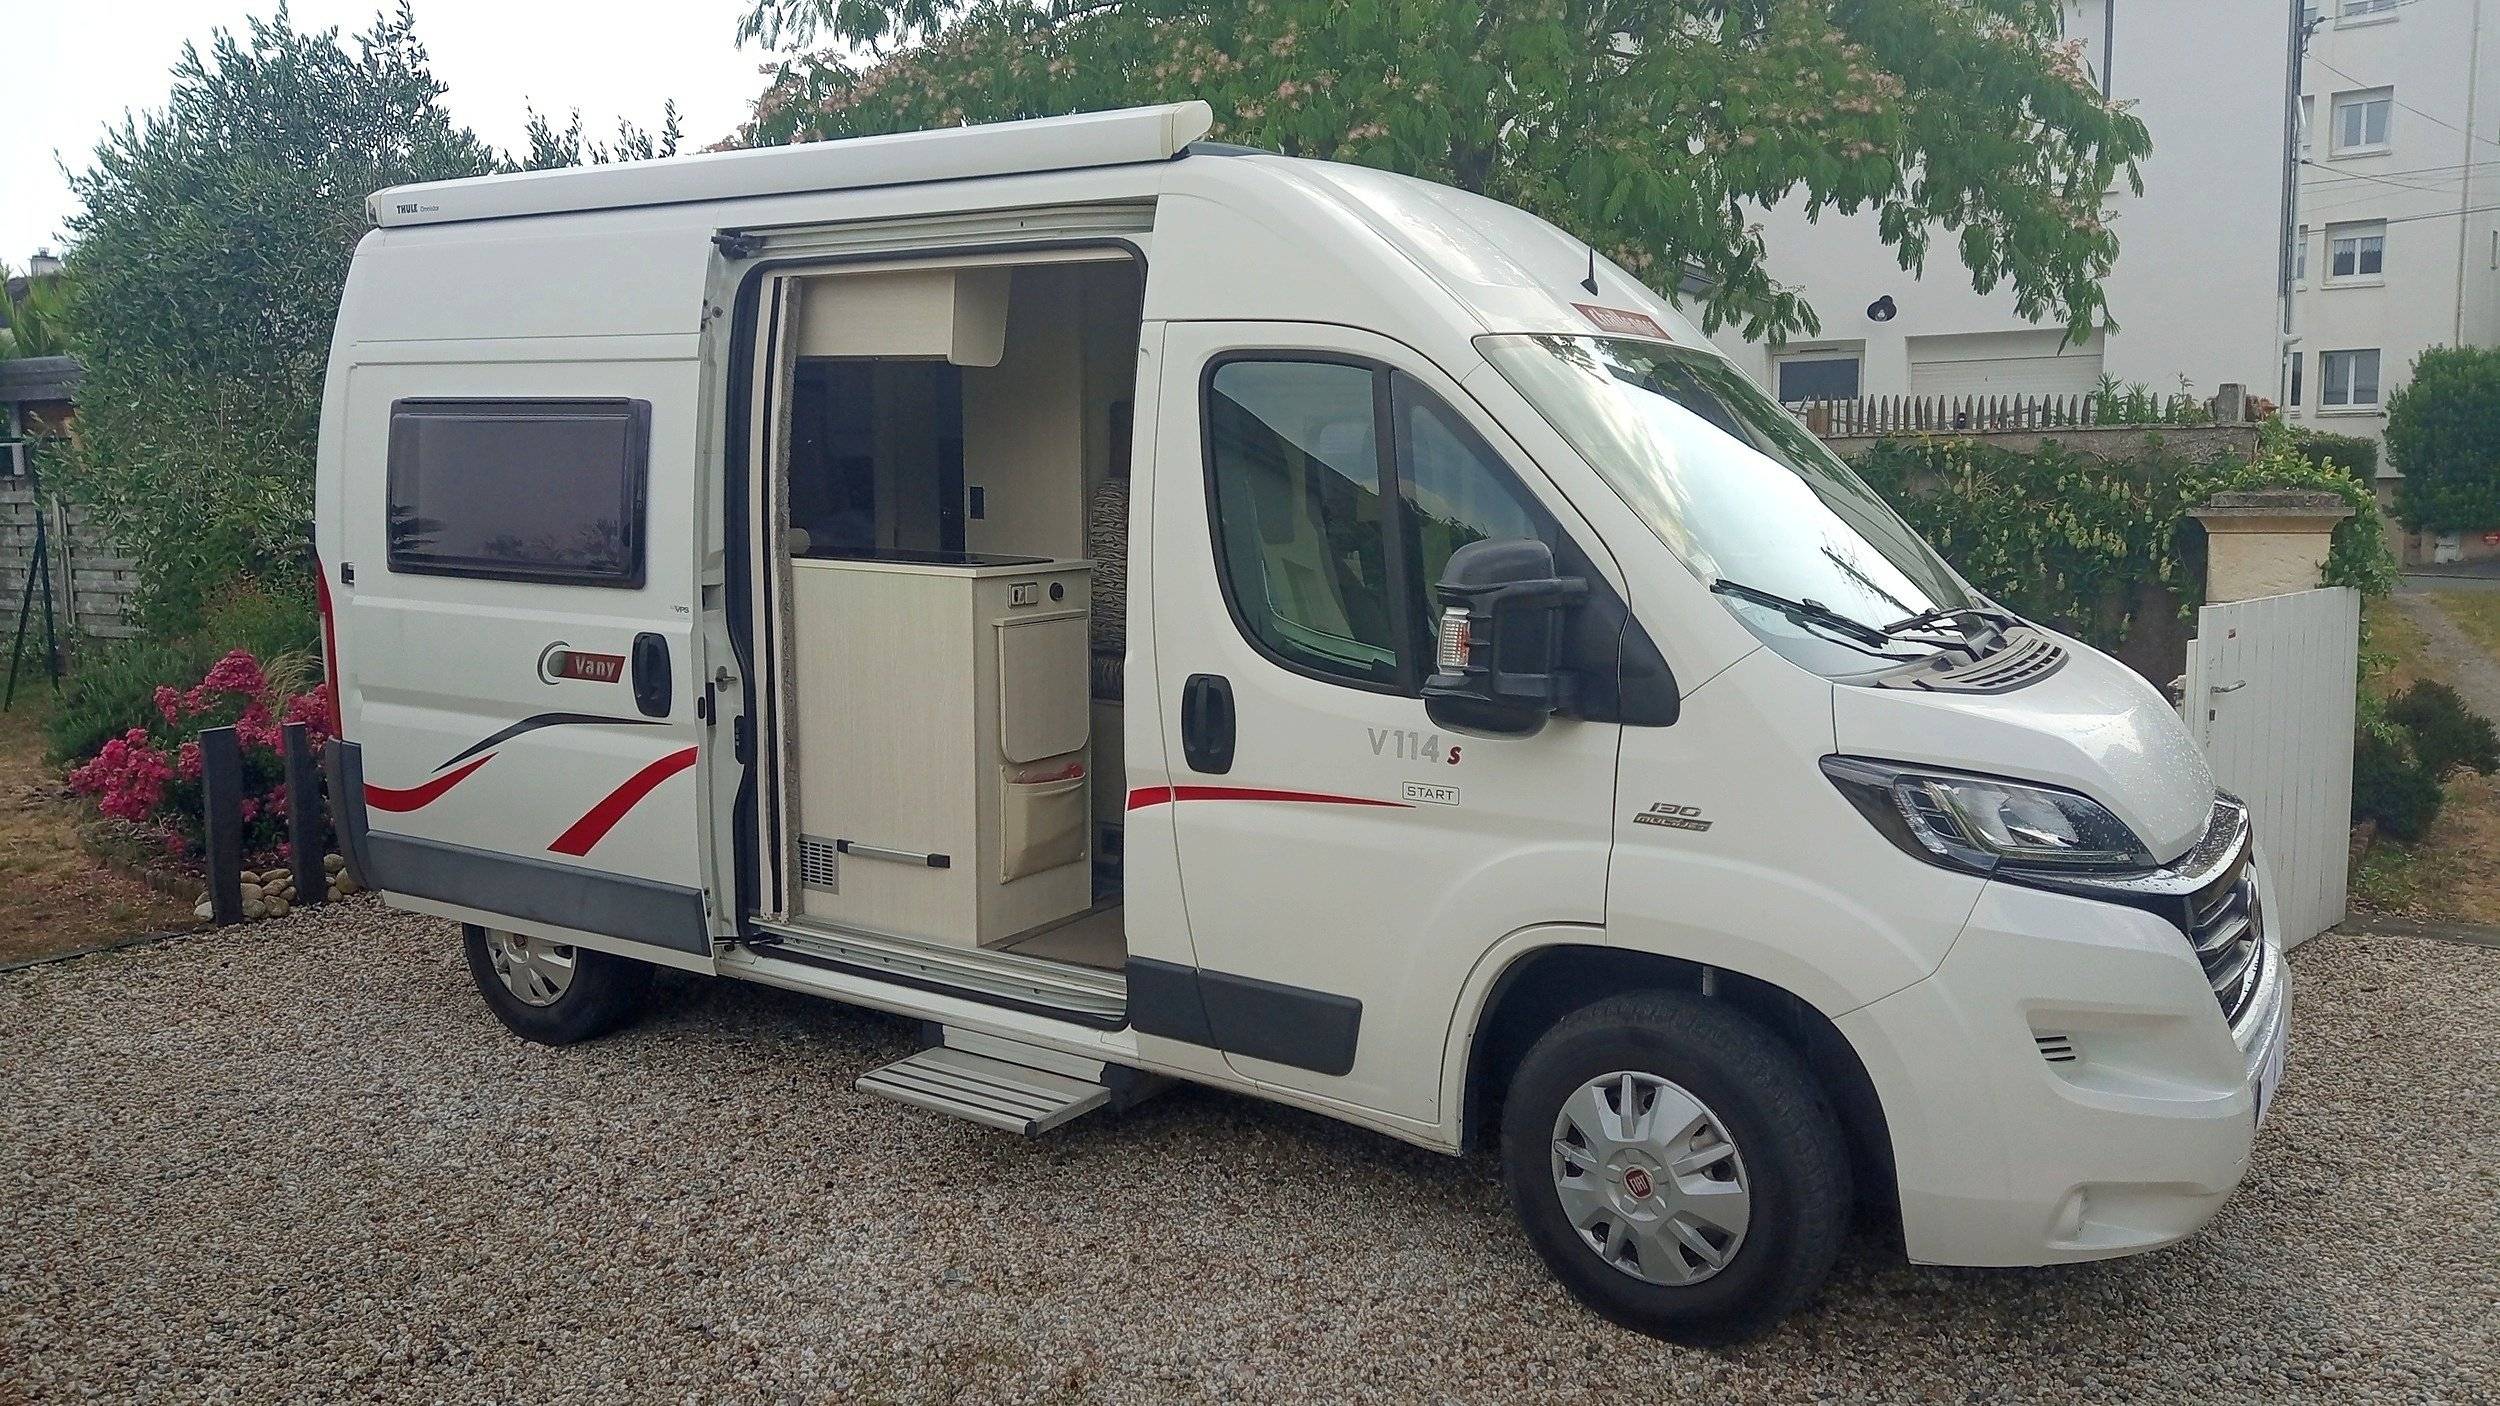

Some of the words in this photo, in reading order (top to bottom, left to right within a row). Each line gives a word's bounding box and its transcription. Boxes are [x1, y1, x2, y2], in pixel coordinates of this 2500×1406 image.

[396, 203, 418, 214] THULE
[575, 655, 616, 678] Vany
[1367, 727, 1440, 764] V114
[1407, 786, 1455, 801] START
[1649, 802, 1702, 818] 130
